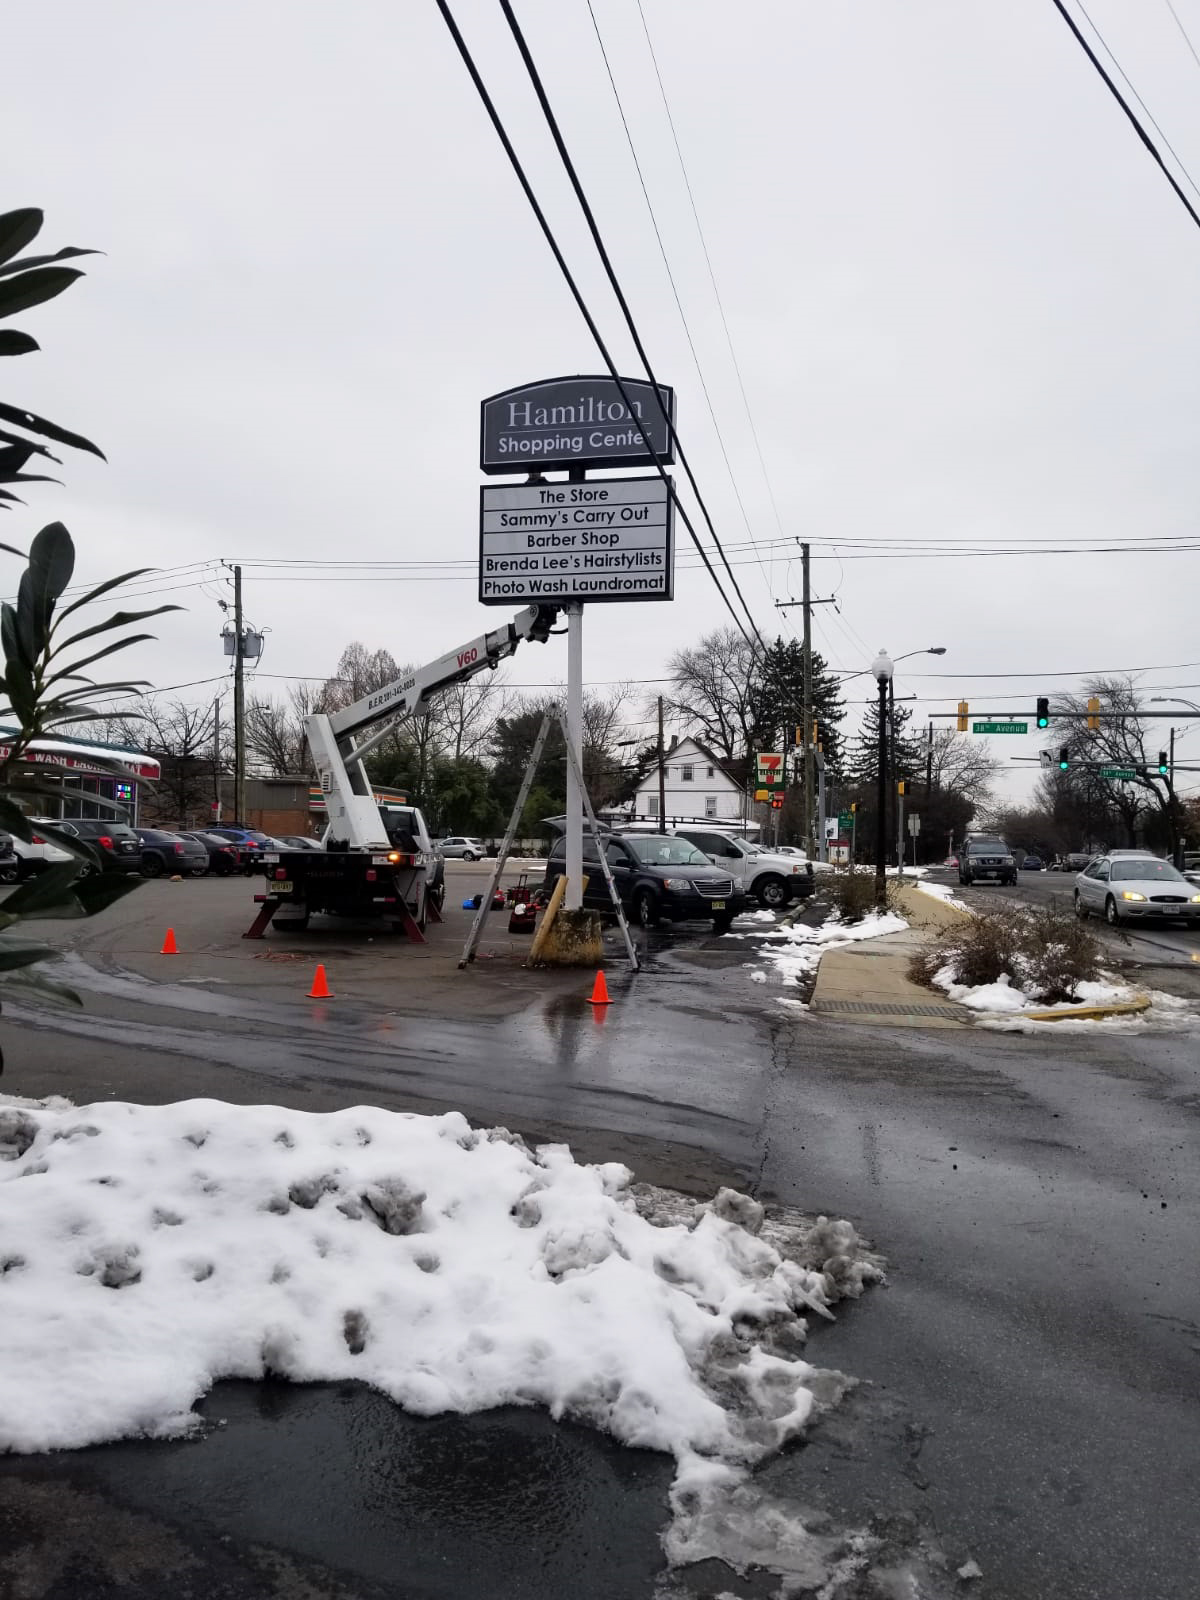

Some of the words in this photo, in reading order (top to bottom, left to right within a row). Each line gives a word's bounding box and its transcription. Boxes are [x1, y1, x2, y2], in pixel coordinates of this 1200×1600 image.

[507, 395, 643, 427] Hamilton
[499, 434, 583, 454] Shopping
[539, 490, 565, 504] The
[570, 488, 609, 502] Store
[500, 511, 568, 527] Sammy's
[573, 509, 615, 525] Carry
[620, 506, 649, 521] Out
[527, 533, 577, 548] Barber
[581, 531, 620, 547] Shop
[486, 556, 539, 572] Brenda
[542, 555, 580, 569] Lee's
[584, 551, 662, 569] Hairstylists
[484, 580, 525, 595] Photo
[528, 578, 568, 593] Wash
[572, 575, 664, 592] Laundromat
[456, 647, 478, 668] V60
[995, 724, 1025, 733] Avenue
[34, 753, 67, 768] WASH
